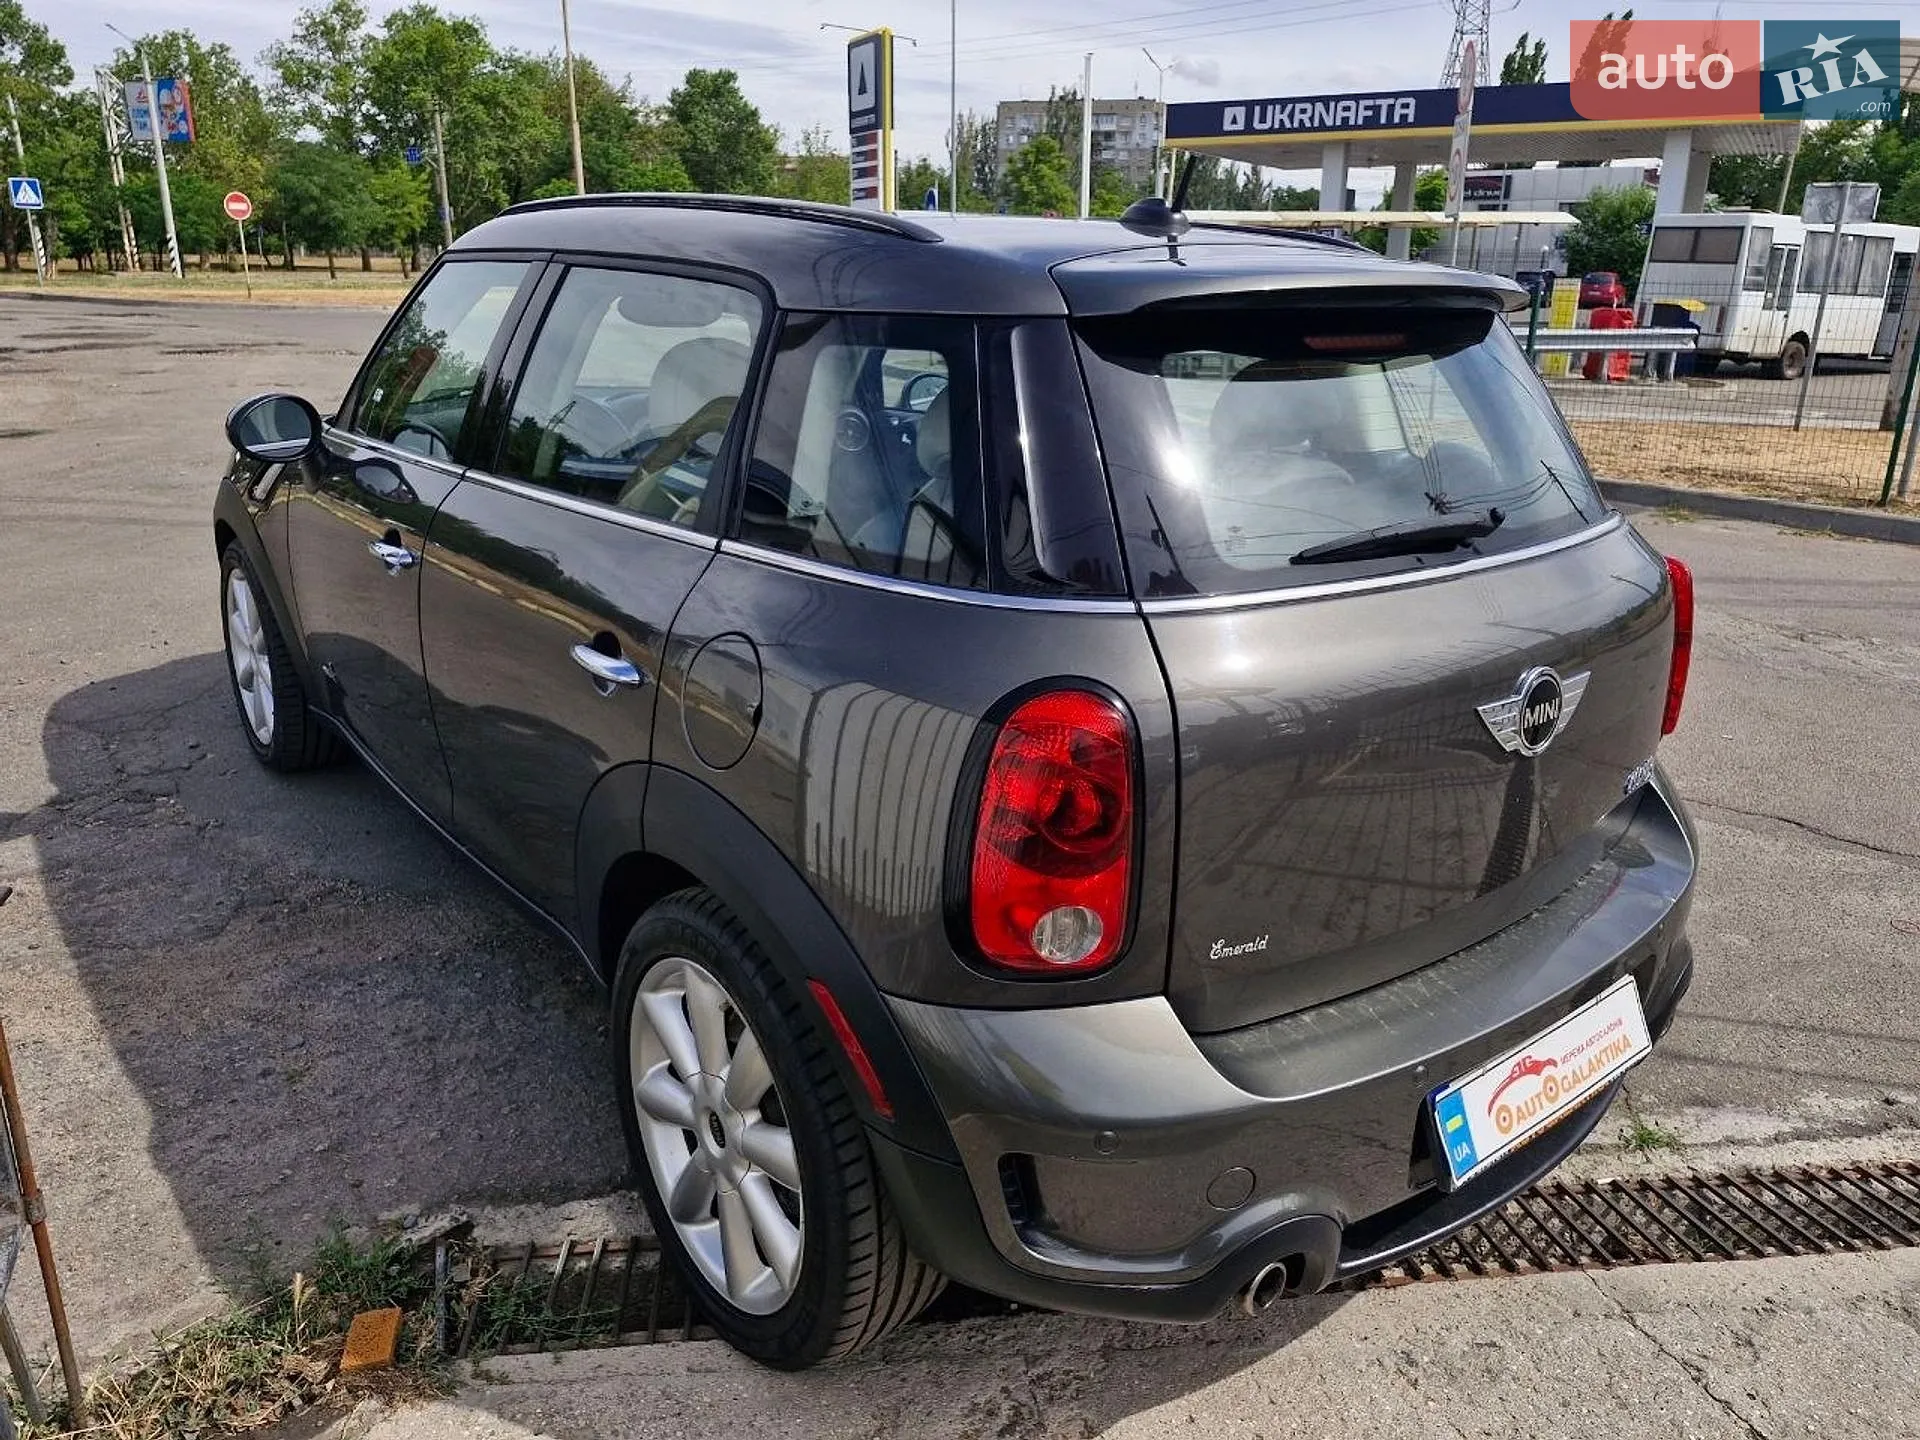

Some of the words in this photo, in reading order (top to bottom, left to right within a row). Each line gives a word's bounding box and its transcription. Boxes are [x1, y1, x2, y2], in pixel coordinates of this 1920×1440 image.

[1252, 97, 1416, 130] UKRNAFTA
[1523, 697, 1560, 729] MINI
[1210, 934, 1269, 959] Emerald
[1454, 1143, 1472, 1163] UA
